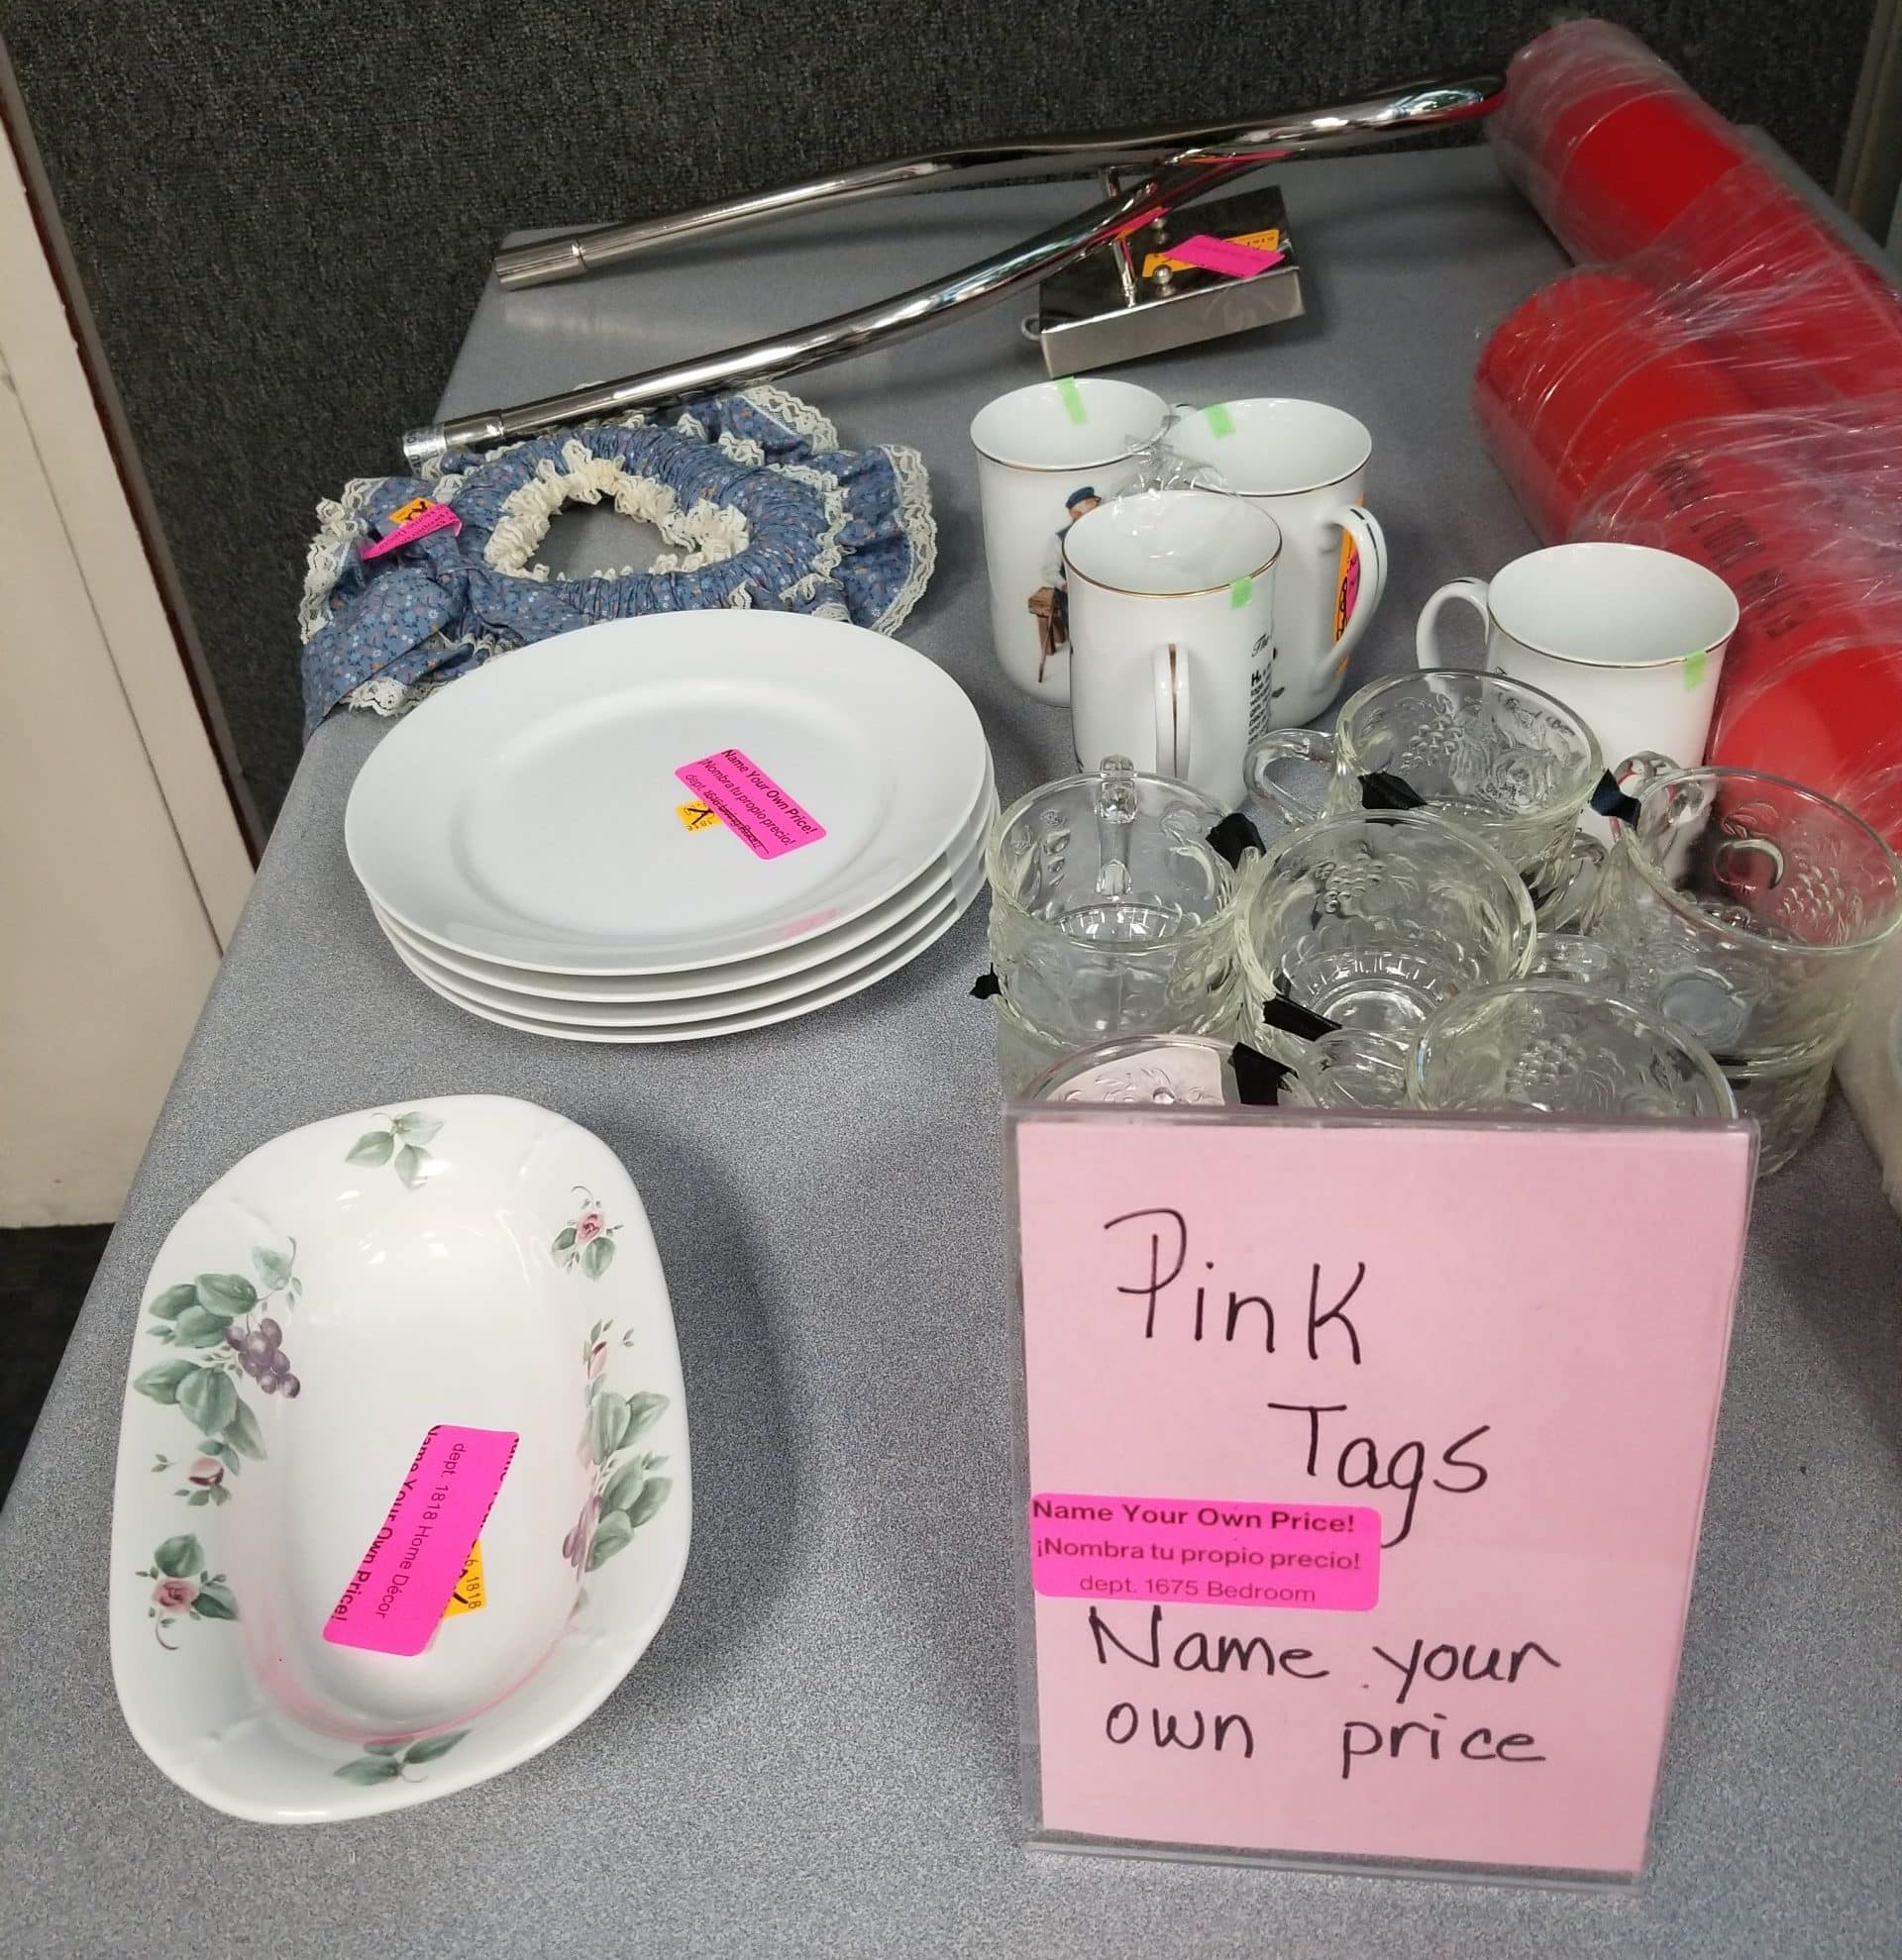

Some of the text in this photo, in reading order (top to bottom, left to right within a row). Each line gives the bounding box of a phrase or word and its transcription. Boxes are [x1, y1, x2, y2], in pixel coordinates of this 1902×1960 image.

[721, 750, 818, 834] Name Your Own Price!
[730, 786, 742, 797] tu
[735, 793, 767, 820] propio
[759, 818, 796, 846] precio!
[1267, 1401, 1491, 1550] Tags
[375, 1443, 467, 1619] dept. 1818 Home Décor
[1032, 1499, 1354, 1532] Name Your Own Price!
[363, 1527, 393, 1564] Own
[1037, 1537, 1360, 1571] ¡Nombra tu propio precio!
[331, 1570, 372, 1621] Price!
[466, 1576, 482, 1609] 1818
[1080, 1575, 1316, 1602] dept. 1675 Bedroom
[1087, 1604, 1562, 1704] Name your
[1105, 1701, 1546, 1780] own price
